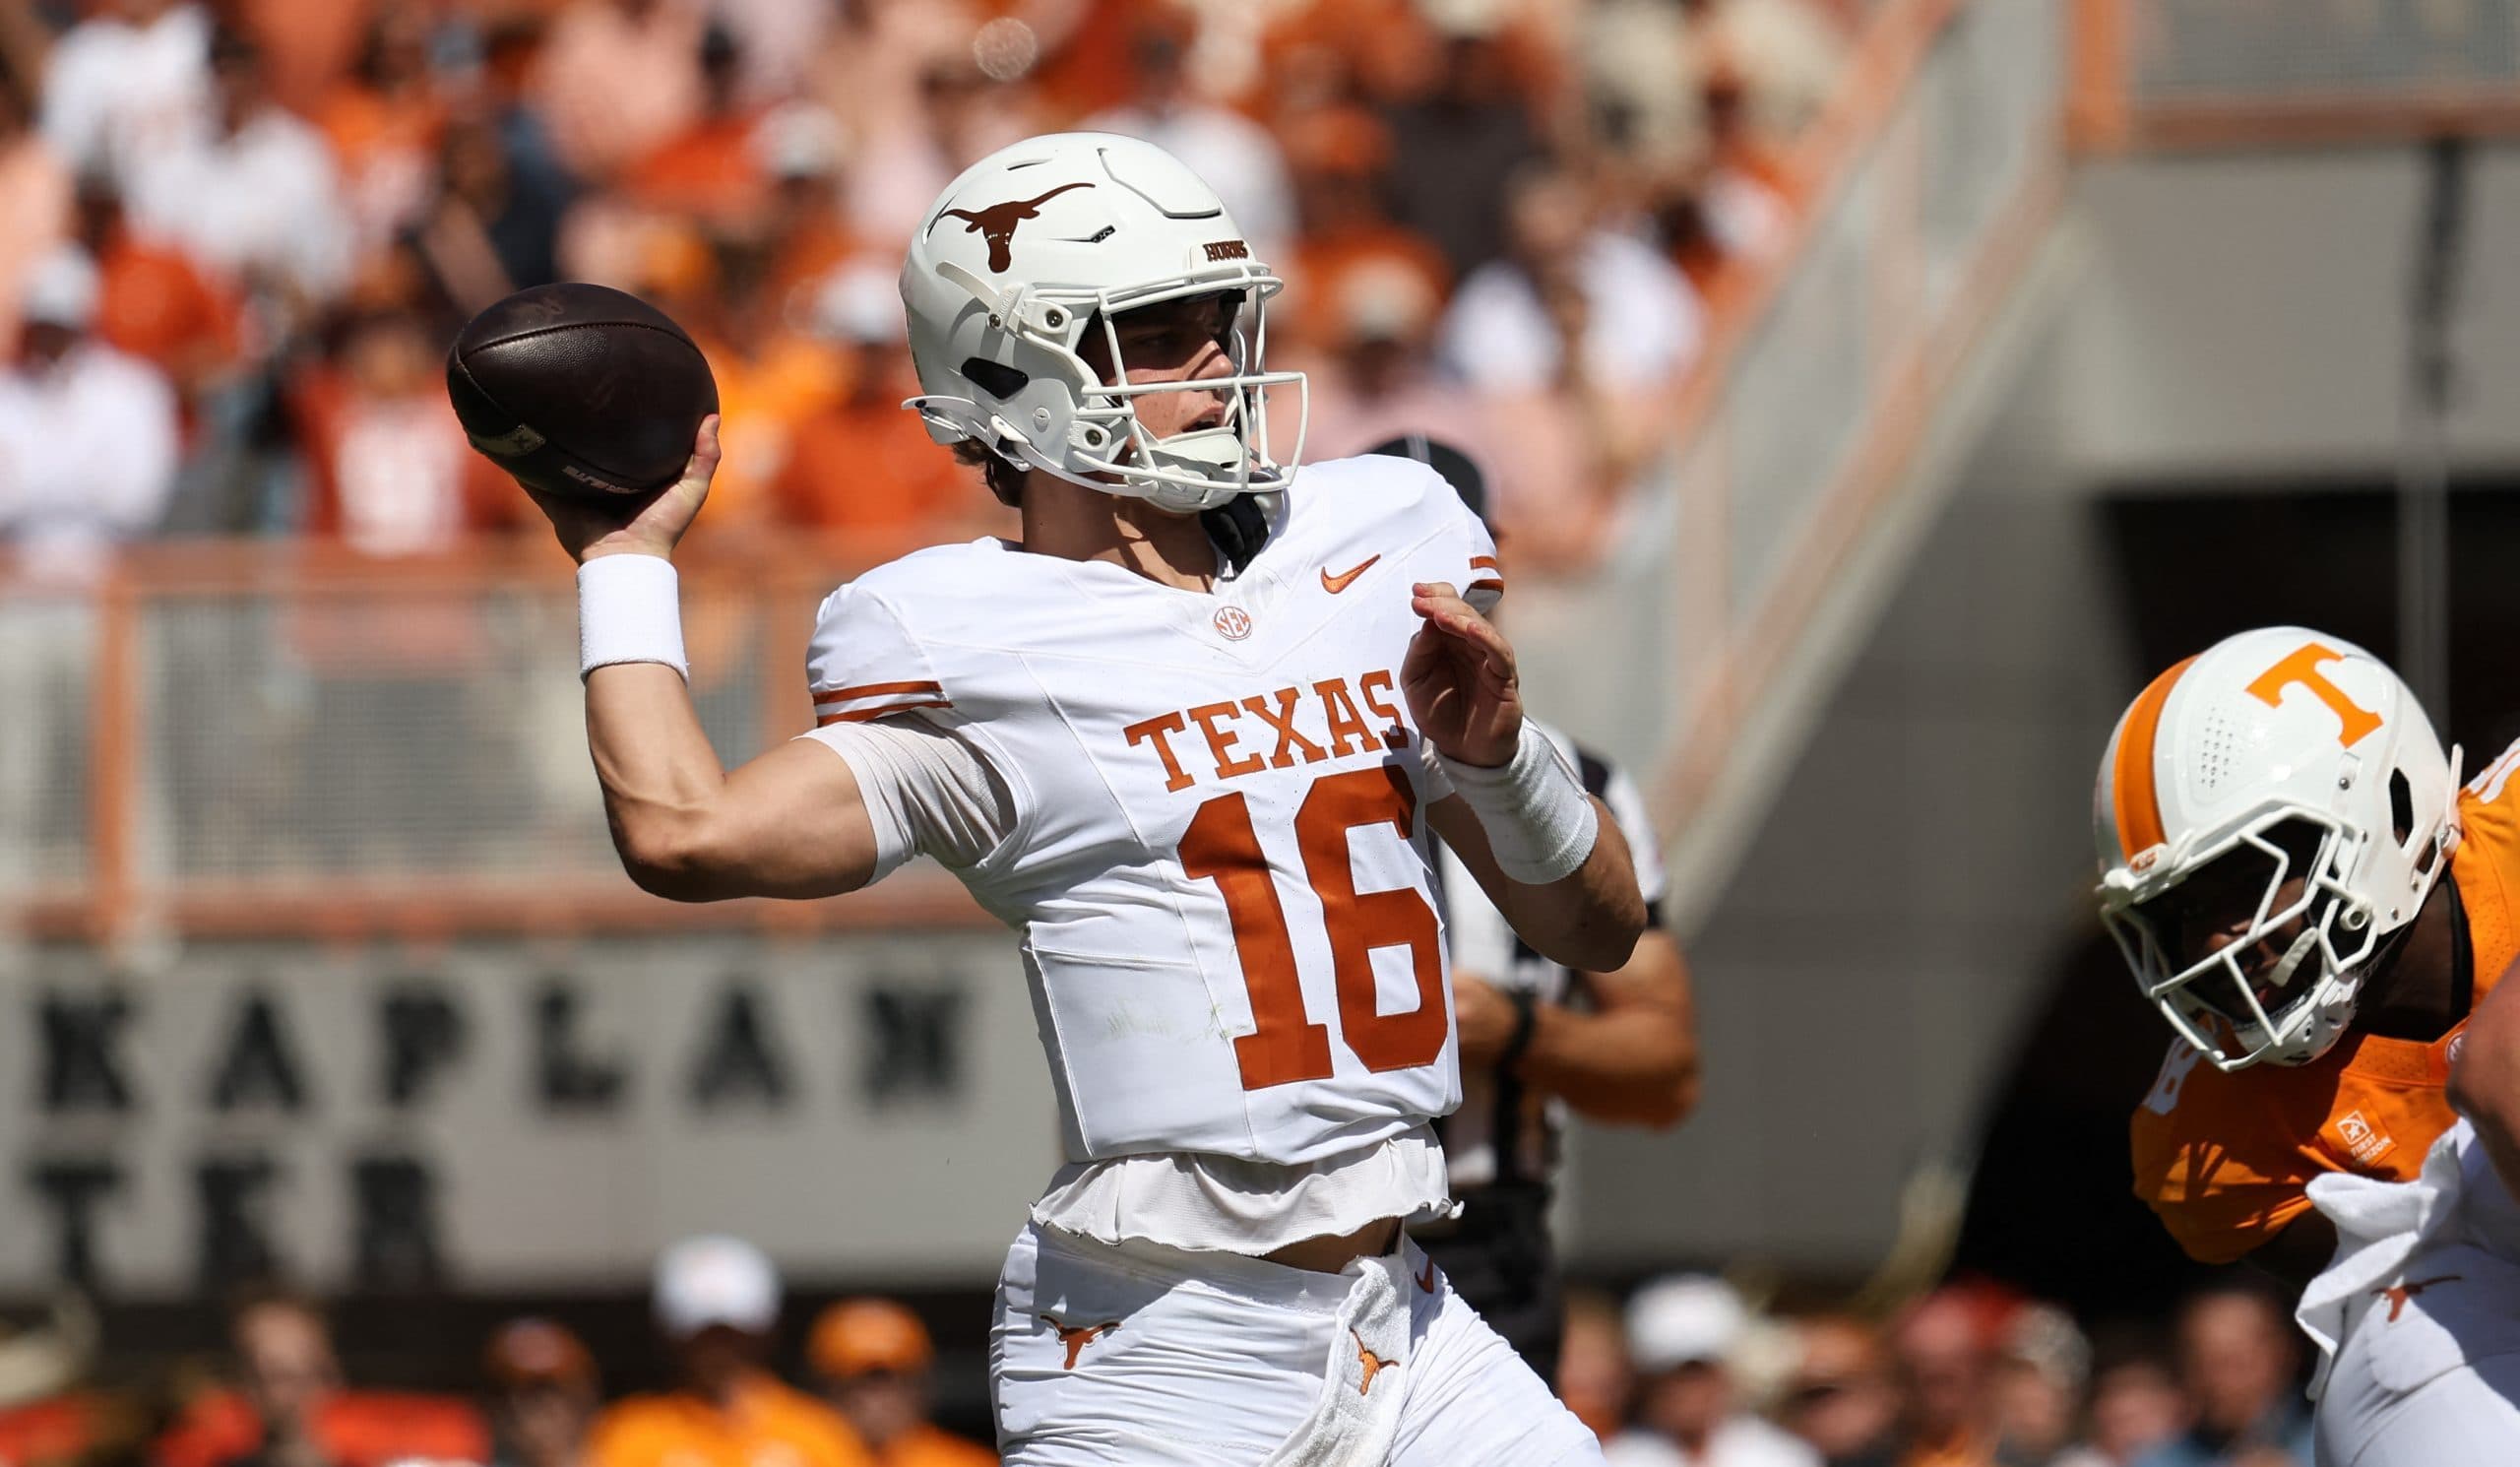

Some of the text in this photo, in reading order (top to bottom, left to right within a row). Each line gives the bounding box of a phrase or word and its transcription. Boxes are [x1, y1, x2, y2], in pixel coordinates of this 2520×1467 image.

[1202, 239, 1249, 263] HORNS
[1214, 606, 1252, 640] SEC
[1123, 669, 1410, 793] TEXAS
[2245, 642, 2383, 748] T
[1176, 764, 1448, 1091] 16
[33, 988, 969, 1115] KAPLAN
[2350, 1133, 2376, 1158] FIRST
